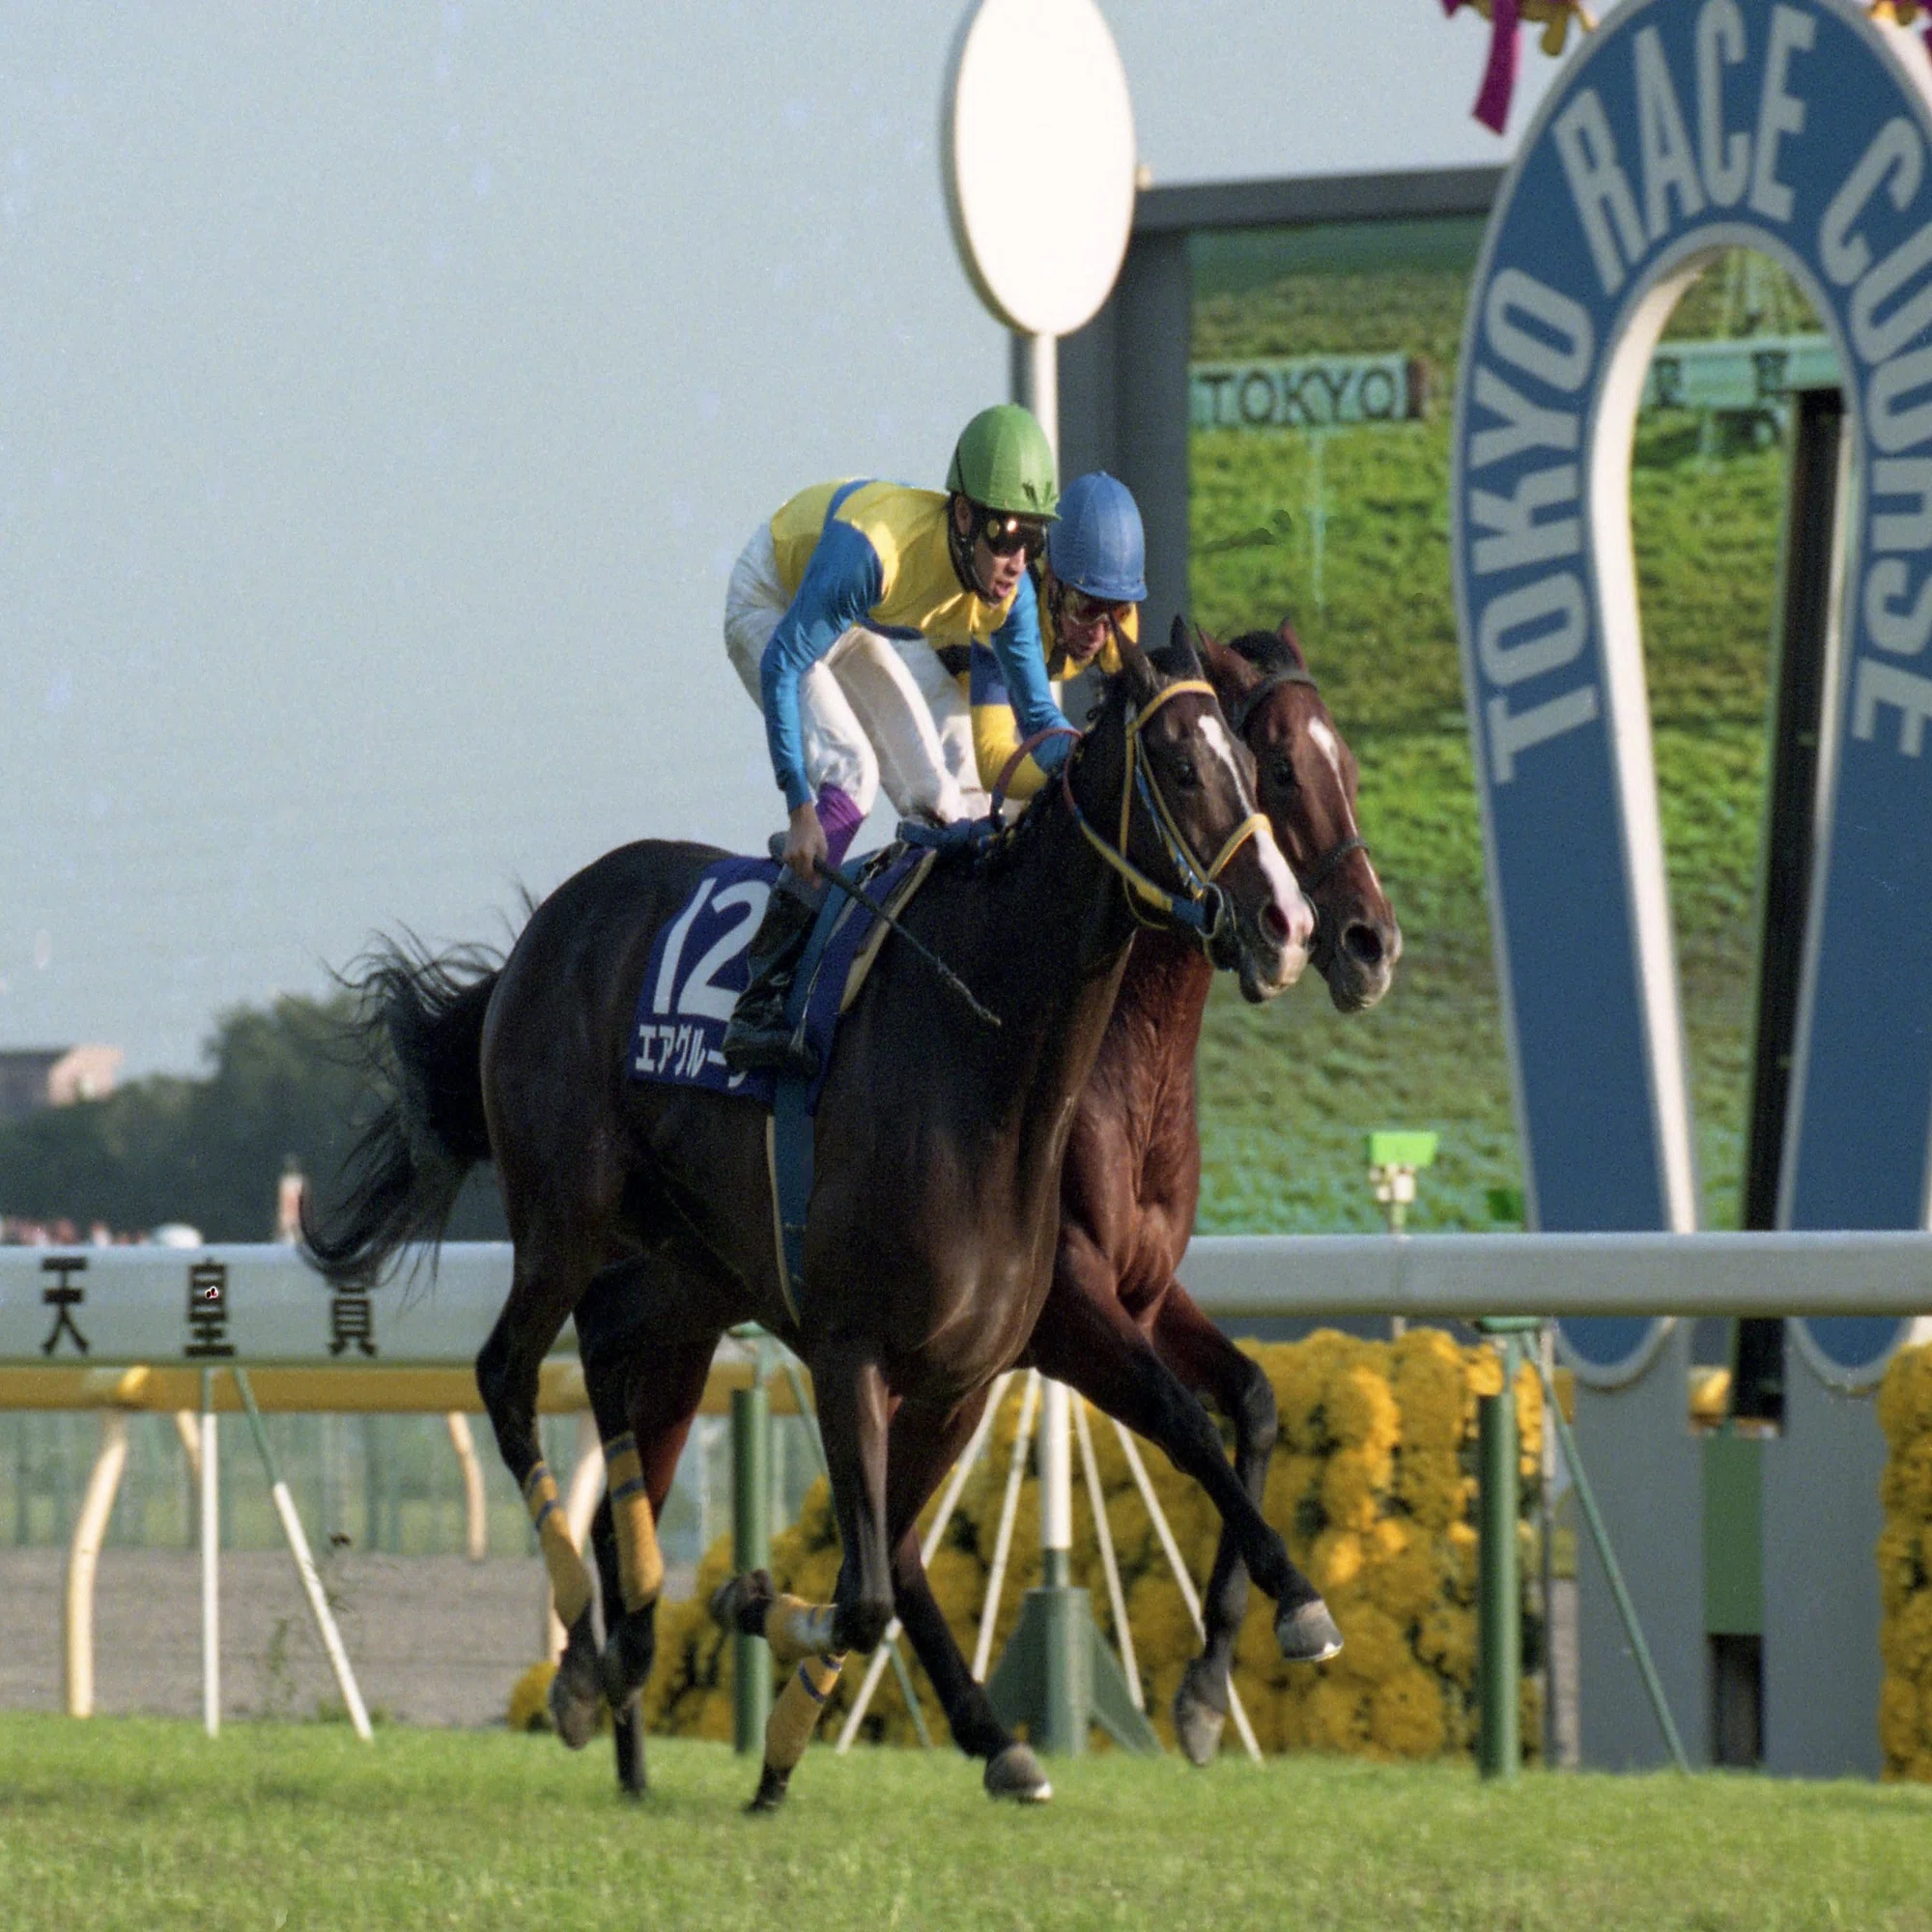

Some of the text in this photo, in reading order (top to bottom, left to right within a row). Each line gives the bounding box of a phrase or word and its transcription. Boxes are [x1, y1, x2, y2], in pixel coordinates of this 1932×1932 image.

[1199, 366, 1396, 426] TOKYO
[1469, 267, 1600, 784] TOKYO
[1552, 0, 1816, 297] RACE
[652, 877, 772, 1023] 12
